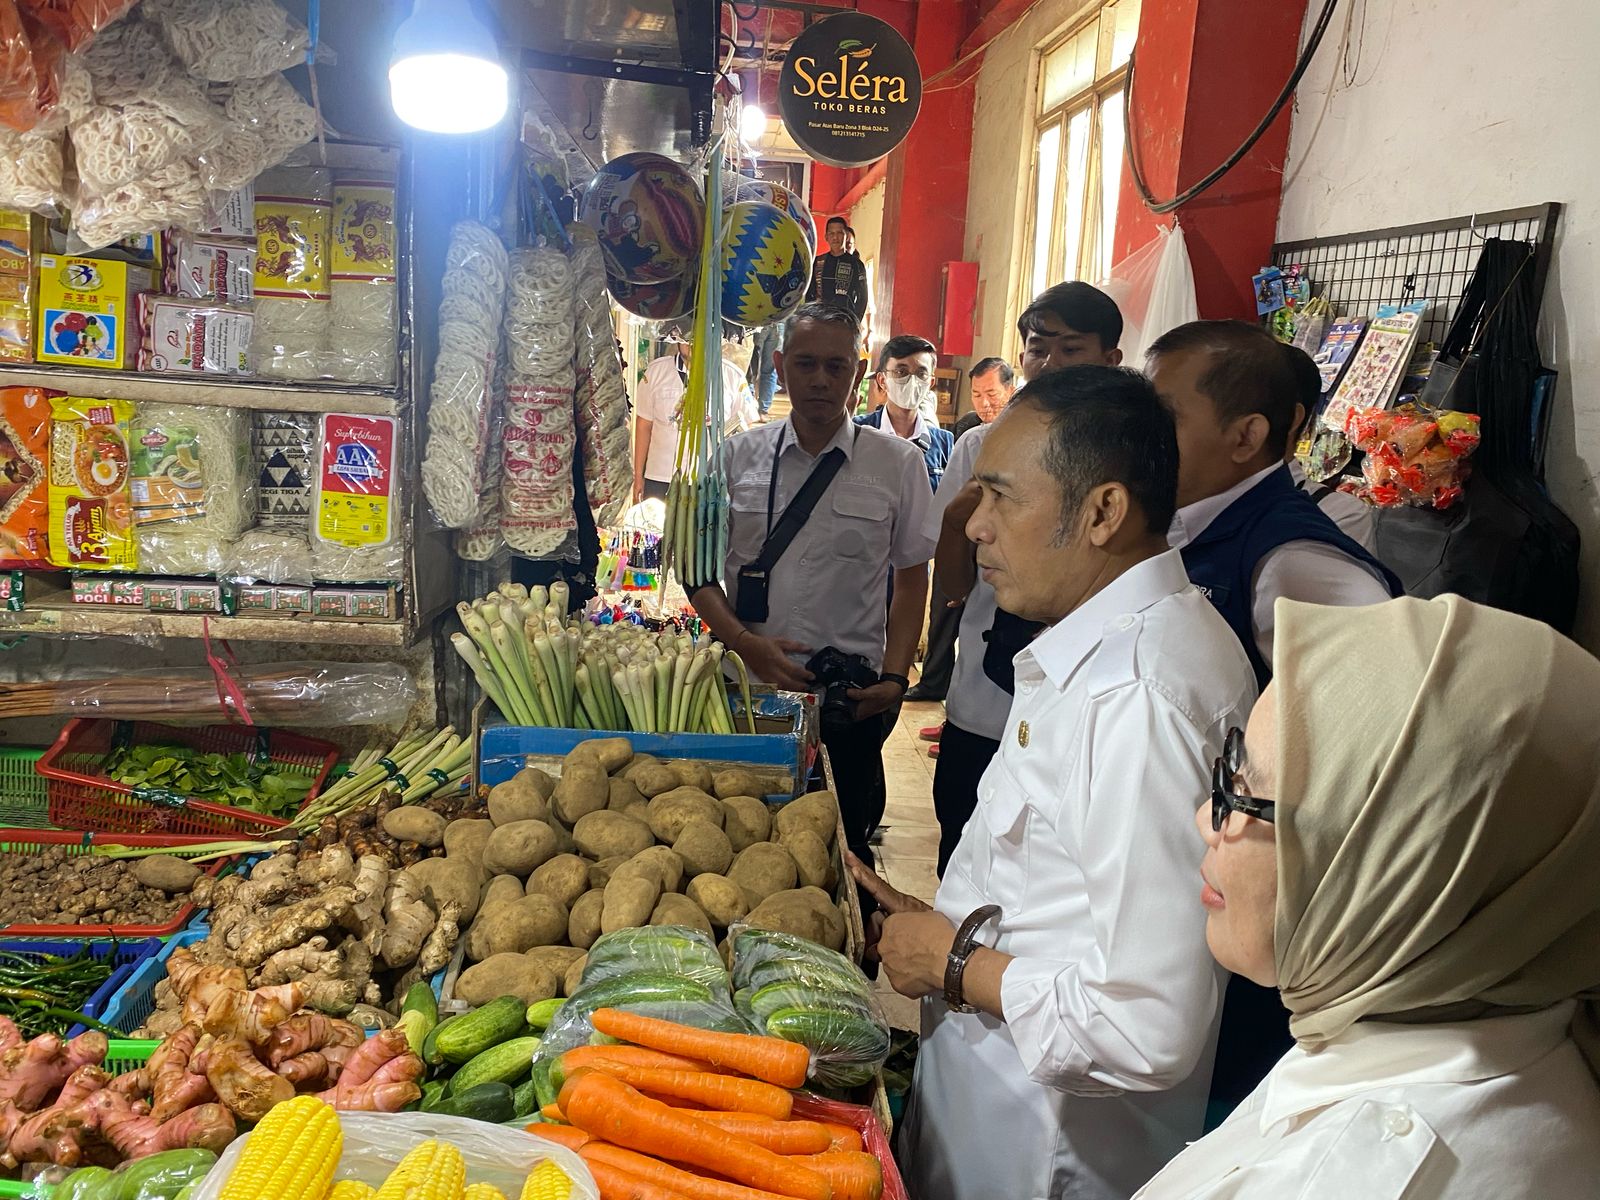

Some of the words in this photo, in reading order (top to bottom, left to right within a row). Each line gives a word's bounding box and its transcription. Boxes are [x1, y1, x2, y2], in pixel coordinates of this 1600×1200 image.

[793, 54, 908, 103] Seléra
[813, 101, 843, 112] TOKO
[849, 103, 887, 115] BERAS
[336, 448, 379, 467] AAA
[87, 506, 107, 541] Ayam
[75, 594, 108, 603] POCI
[114, 595, 143, 604] POC
